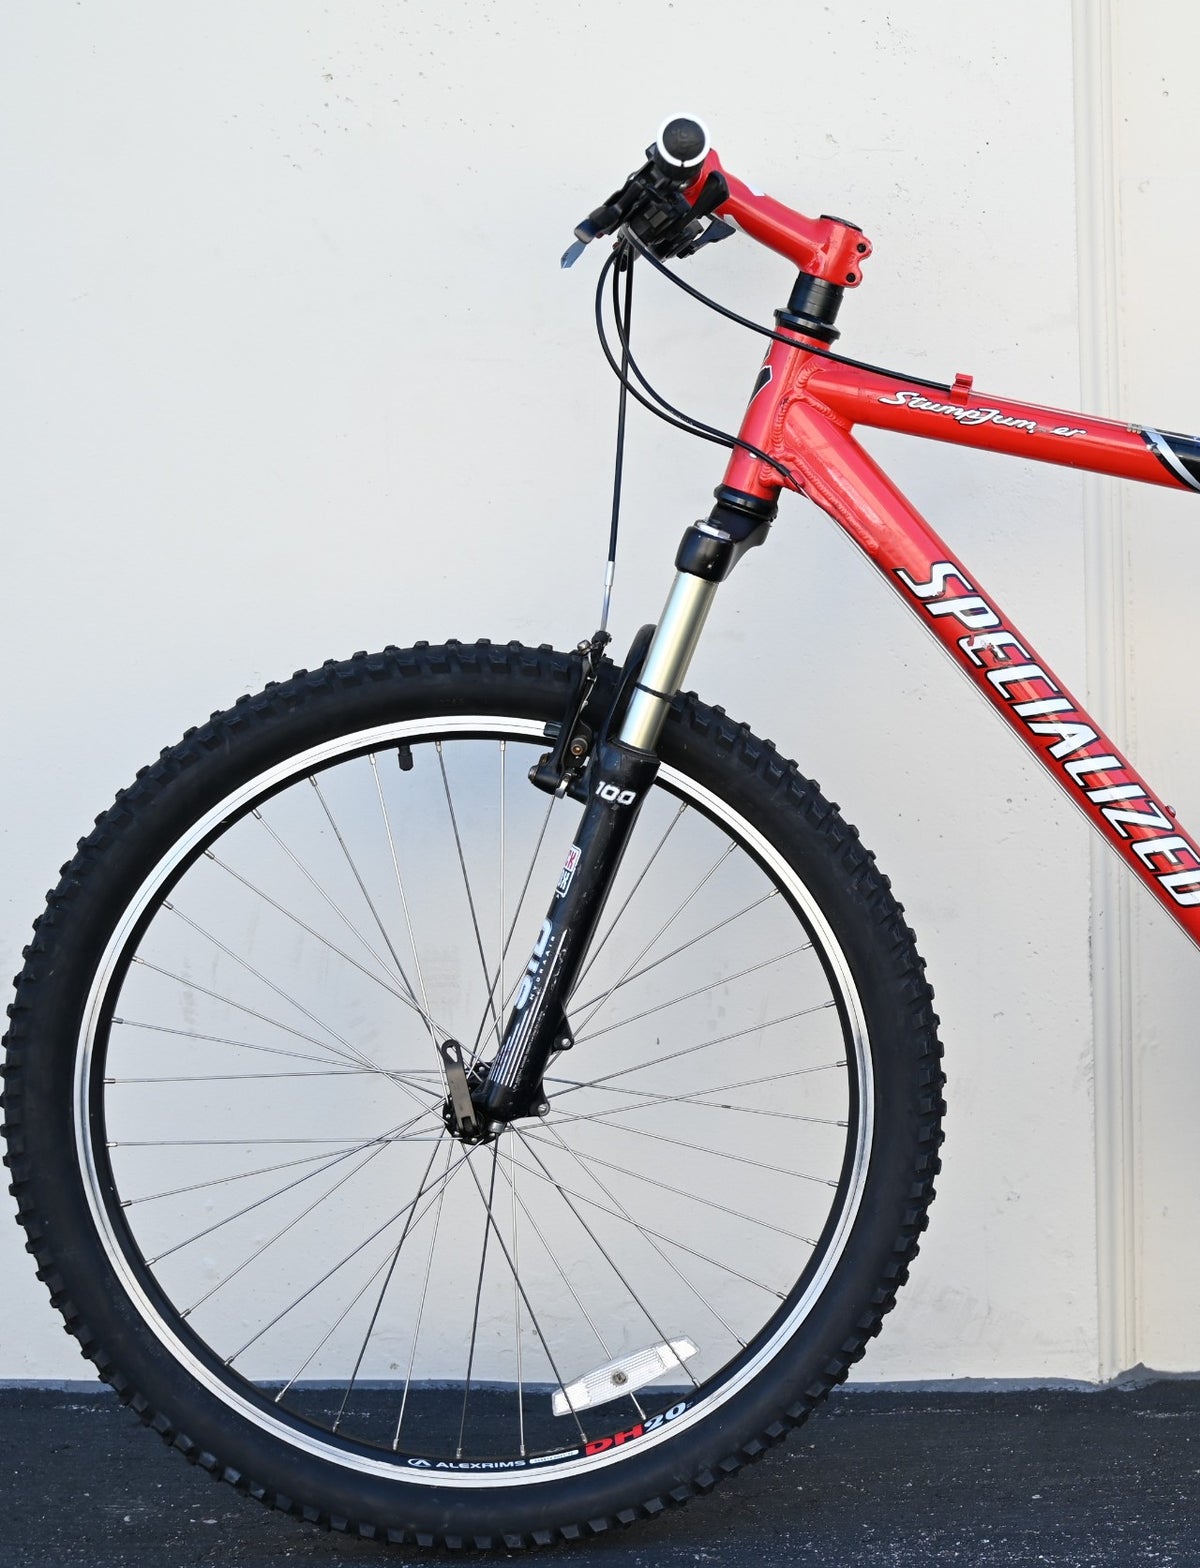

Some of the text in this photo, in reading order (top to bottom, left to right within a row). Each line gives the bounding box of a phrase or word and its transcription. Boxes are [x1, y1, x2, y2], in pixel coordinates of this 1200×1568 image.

[879, 391, 1088, 438] StumpJumer
[595, 781, 636, 805] 100
[436, 1459, 526, 1469] ALEXRIMS
